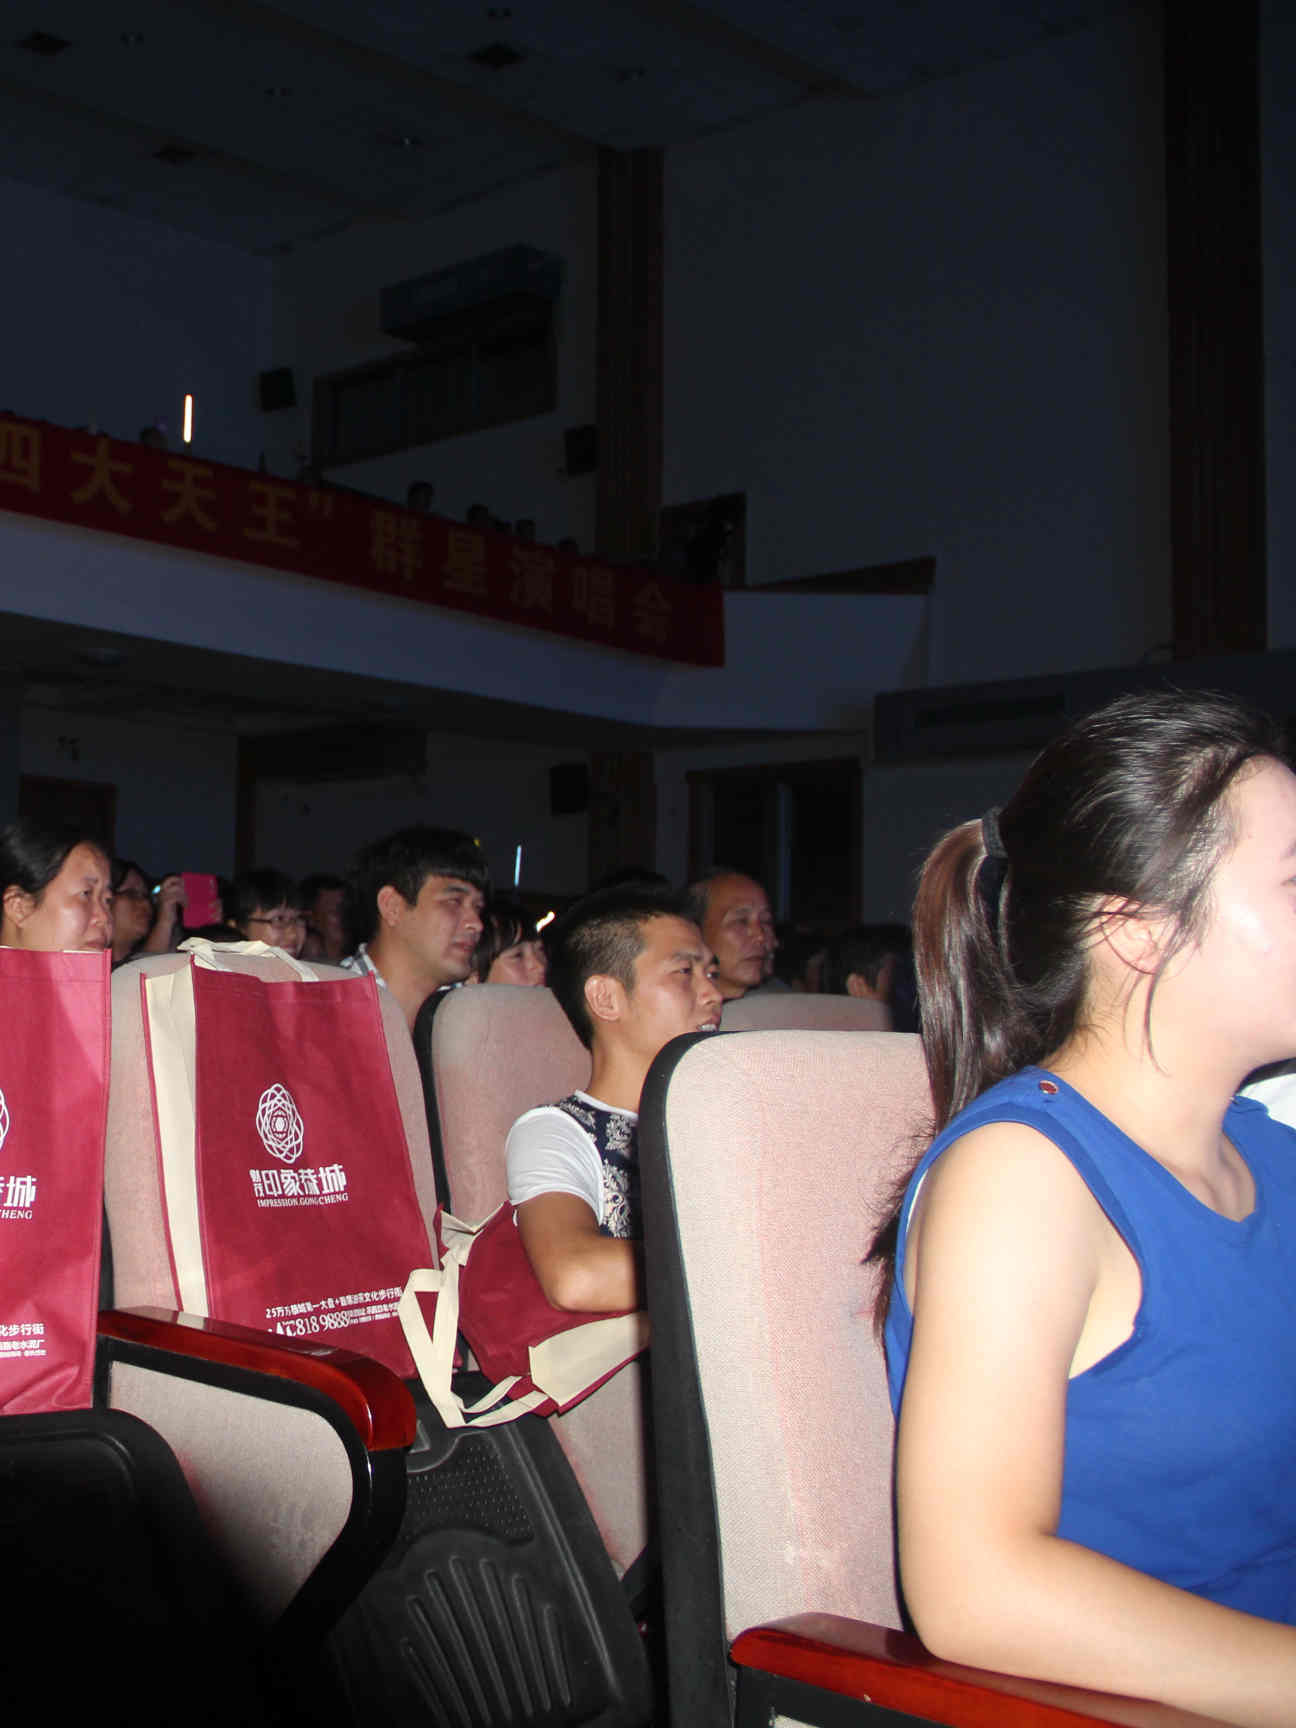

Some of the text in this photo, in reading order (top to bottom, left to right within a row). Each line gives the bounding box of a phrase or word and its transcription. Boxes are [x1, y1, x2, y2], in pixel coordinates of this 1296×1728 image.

[261, 1163, 347, 1197] 印象恭城
[319, 1192, 349, 1206] CHENG
[295, 1317, 320, 1337] 818
[319, 1311, 350, 1330] 9888
